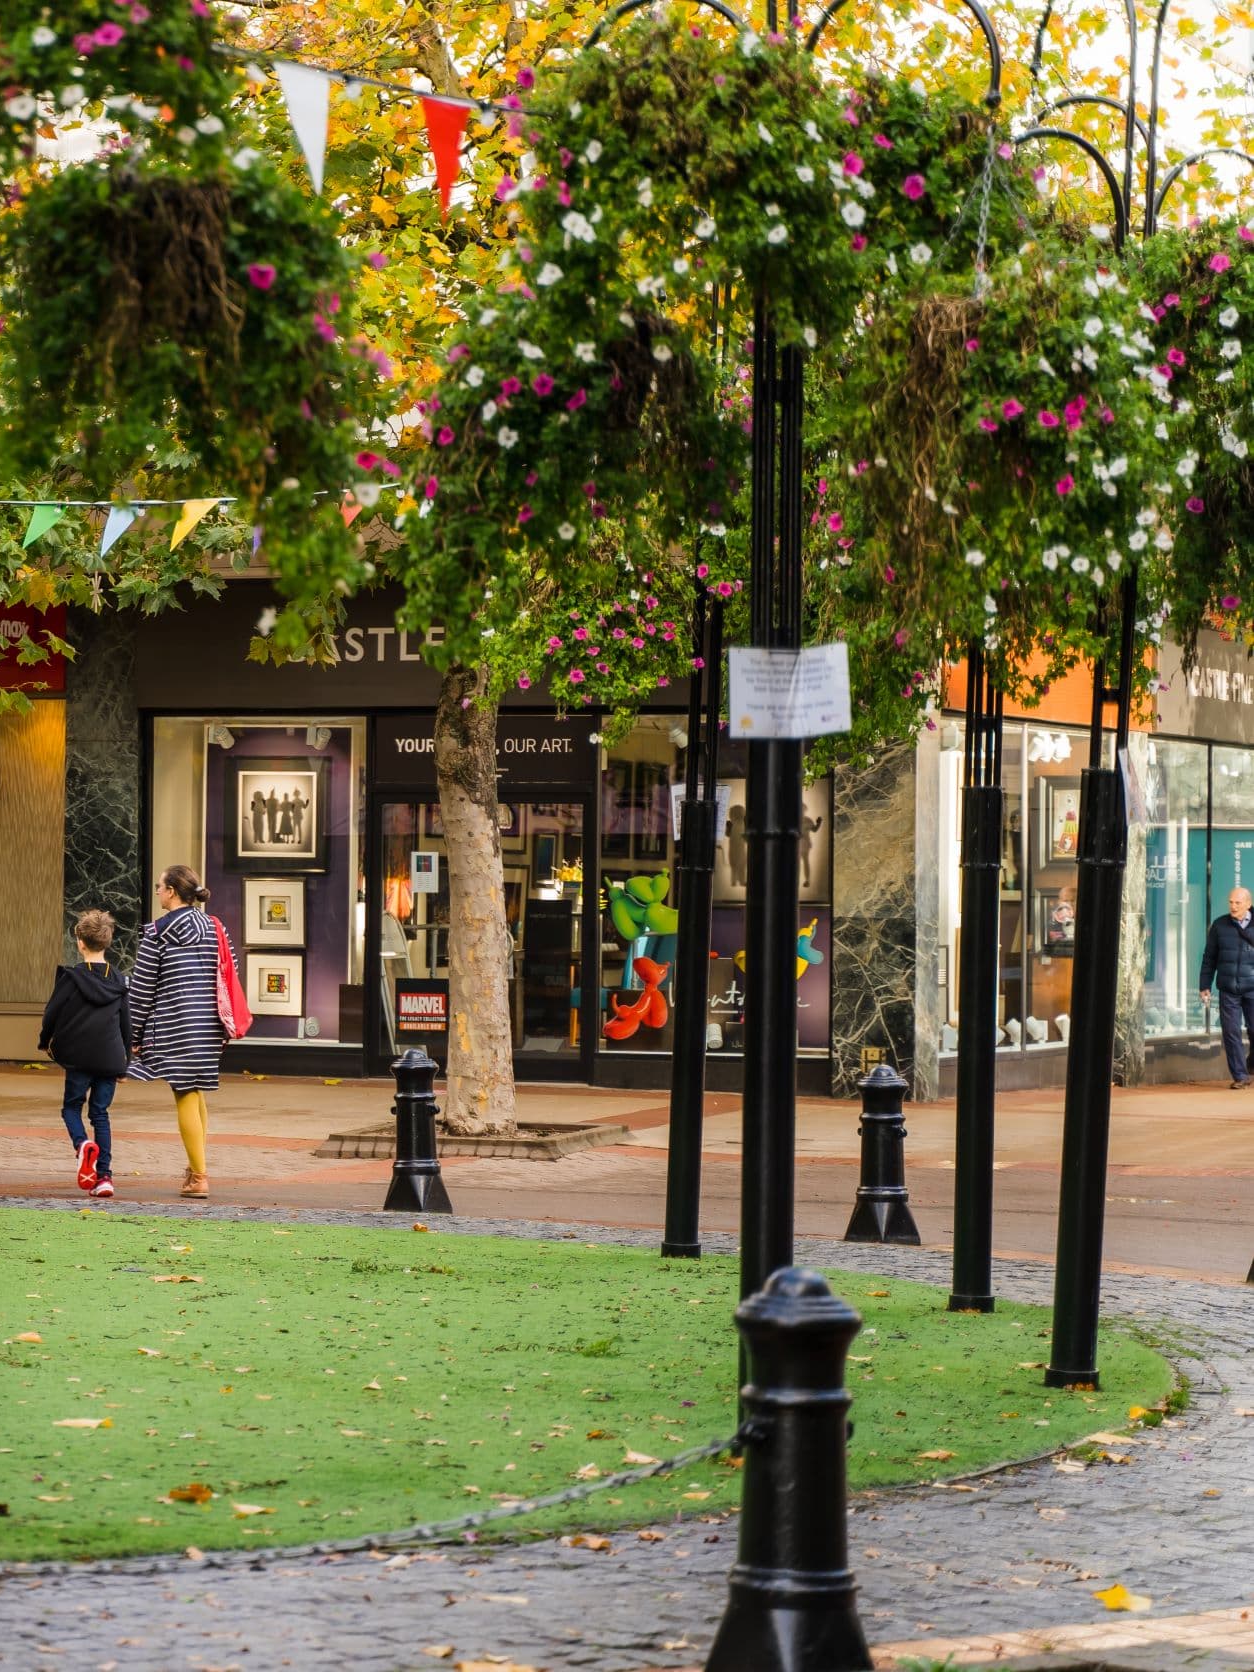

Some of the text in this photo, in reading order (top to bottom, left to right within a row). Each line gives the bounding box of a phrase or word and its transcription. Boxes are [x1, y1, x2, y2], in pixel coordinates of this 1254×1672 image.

[395, 738, 435, 753] YOUR
[504, 738, 536, 753] OUR
[401, 995, 445, 1014] MARVEL
